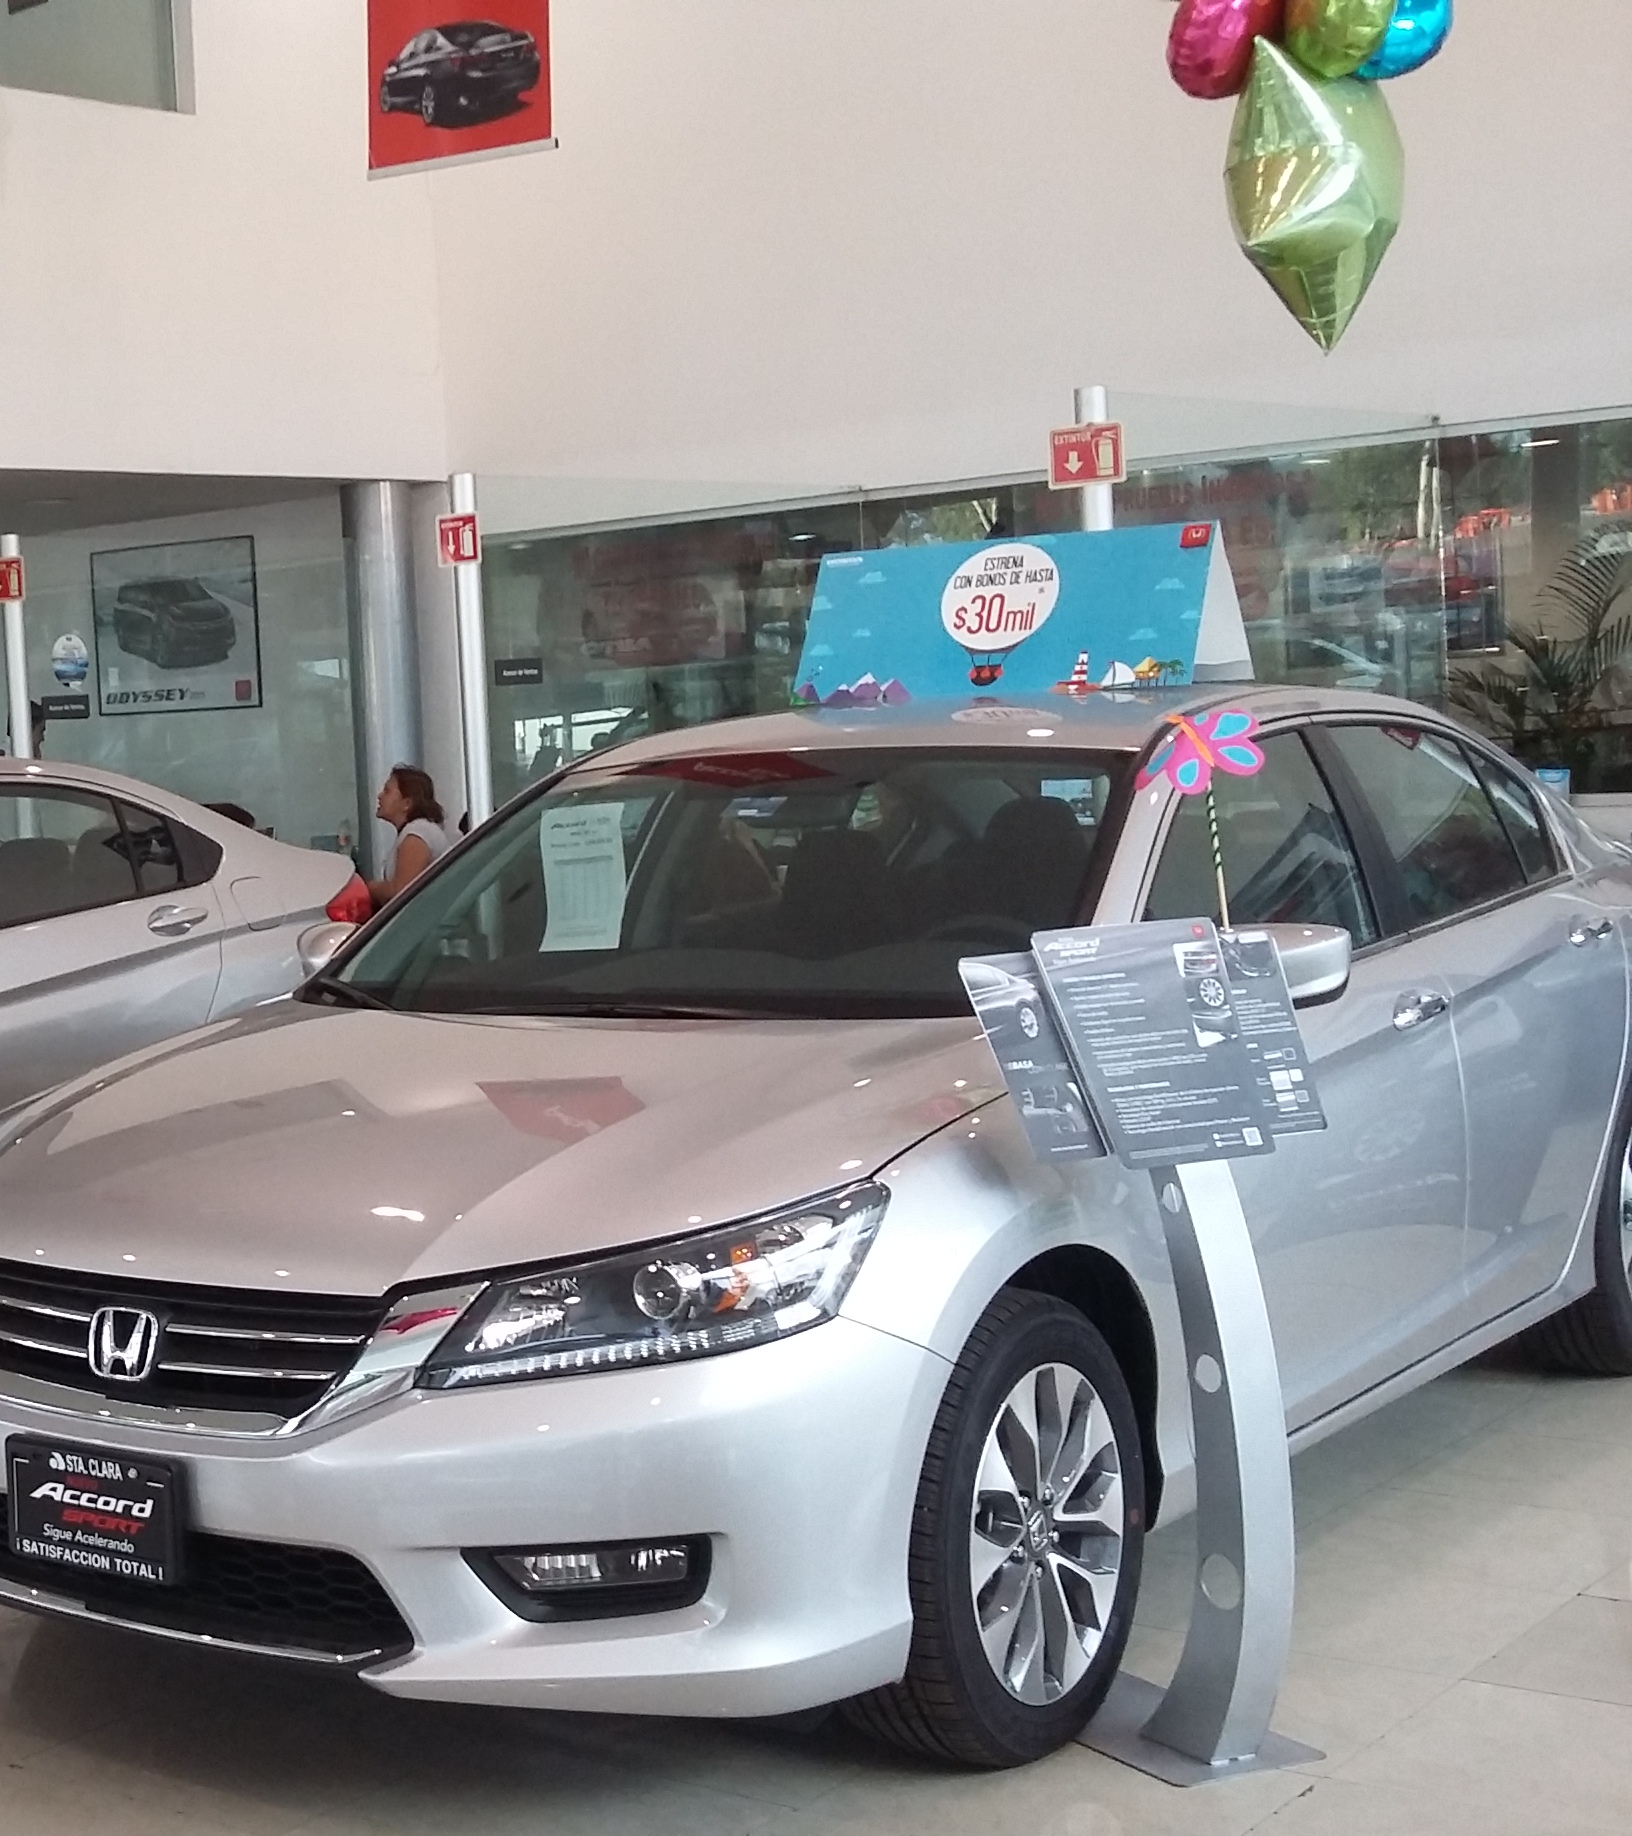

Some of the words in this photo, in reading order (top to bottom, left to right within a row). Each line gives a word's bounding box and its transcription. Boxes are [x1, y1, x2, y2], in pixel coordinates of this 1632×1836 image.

[983, 555, 1024, 571] ESTRENA
[953, 575, 974, 590] CON
[975, 572, 1008, 588] BONOS
[1009, 570, 1024, 586] DE
[1024, 568, 1054, 584] HASTA
[106, 687, 190, 705] ODYSSEY
[66, 1453, 89, 1476] STA.
[88, 1457, 124, 1482] CLARA
[29, 1481, 155, 1519] Accord
[61, 1509, 146, 1536] SPORT
[42, 1522, 73, 1542] Sigue
[74, 1530, 136, 1555] Acelerando
